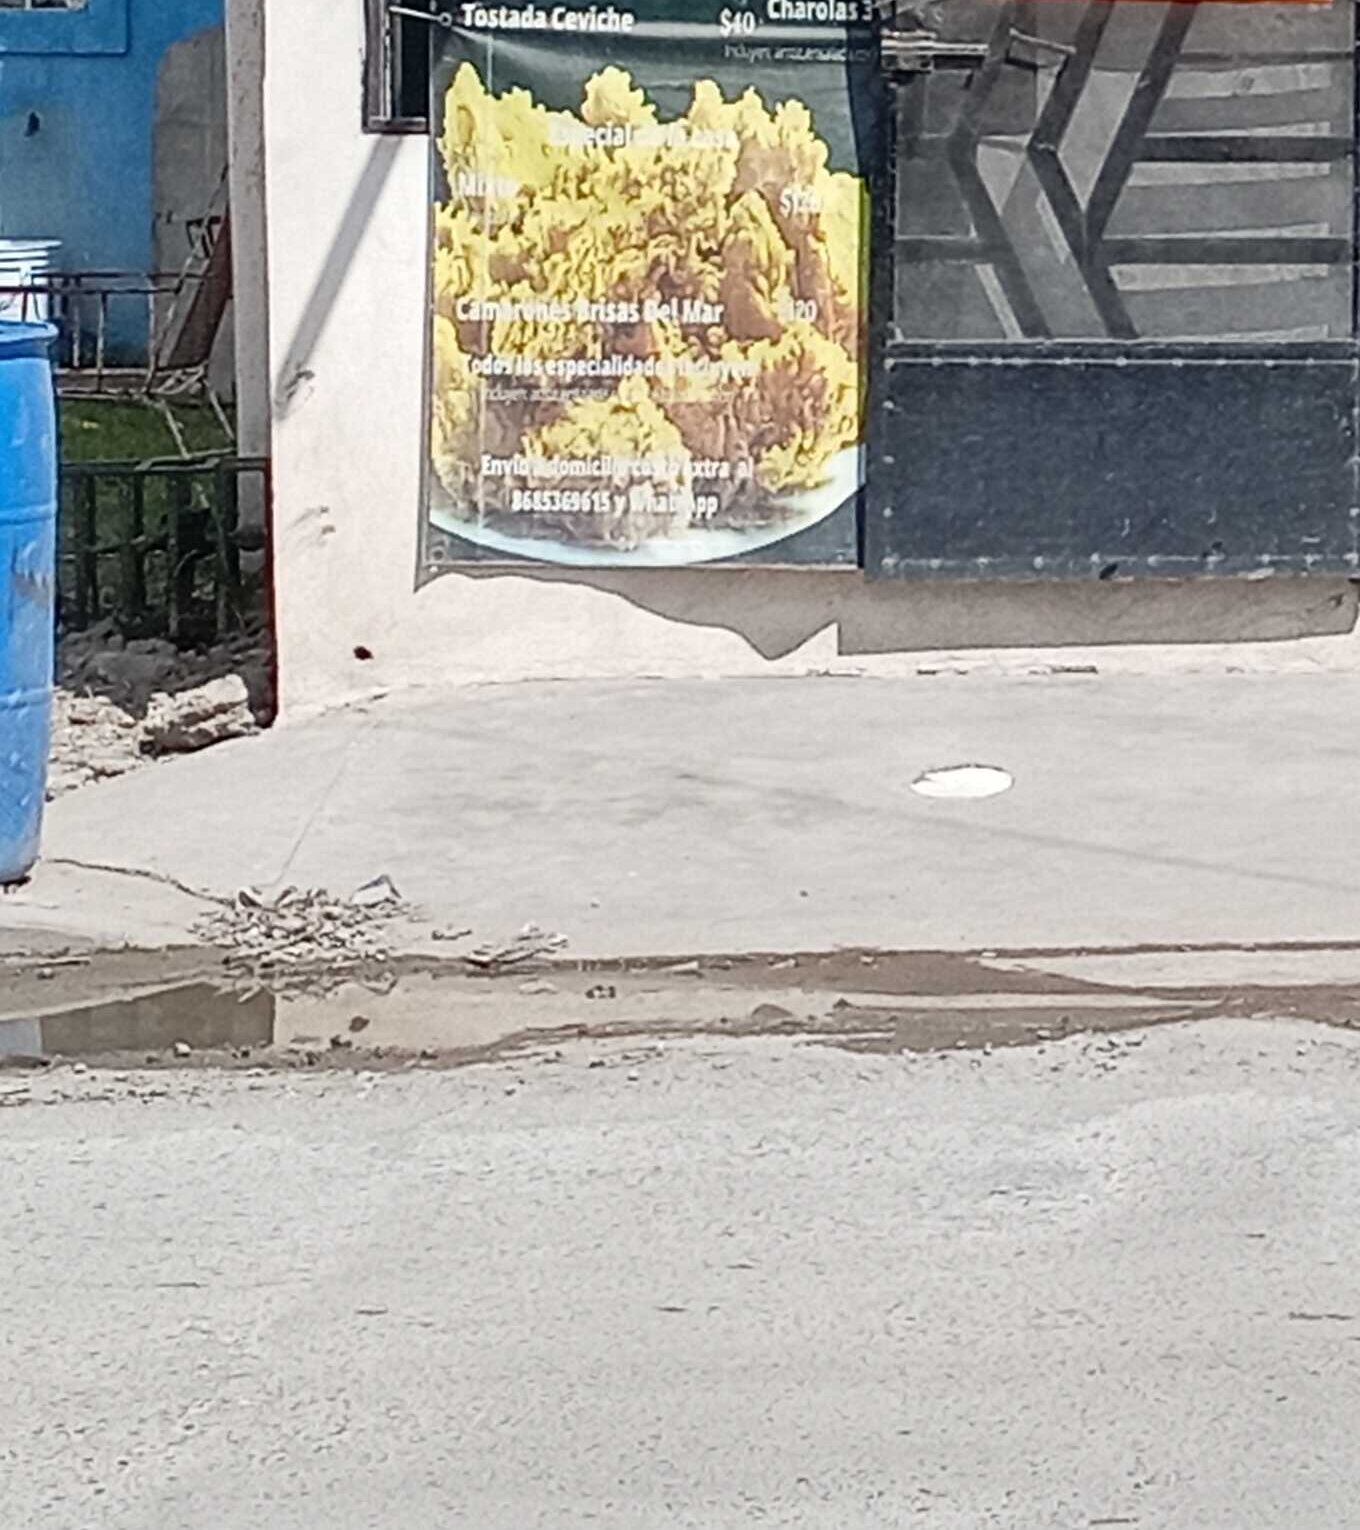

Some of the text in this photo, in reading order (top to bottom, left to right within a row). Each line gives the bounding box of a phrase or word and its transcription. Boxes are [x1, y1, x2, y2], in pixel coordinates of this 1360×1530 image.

[462, 4, 757, 37] Tostada Ceviche $40
[456, 297, 572, 322] Camarones
[683, 300, 724, 324] Mar
